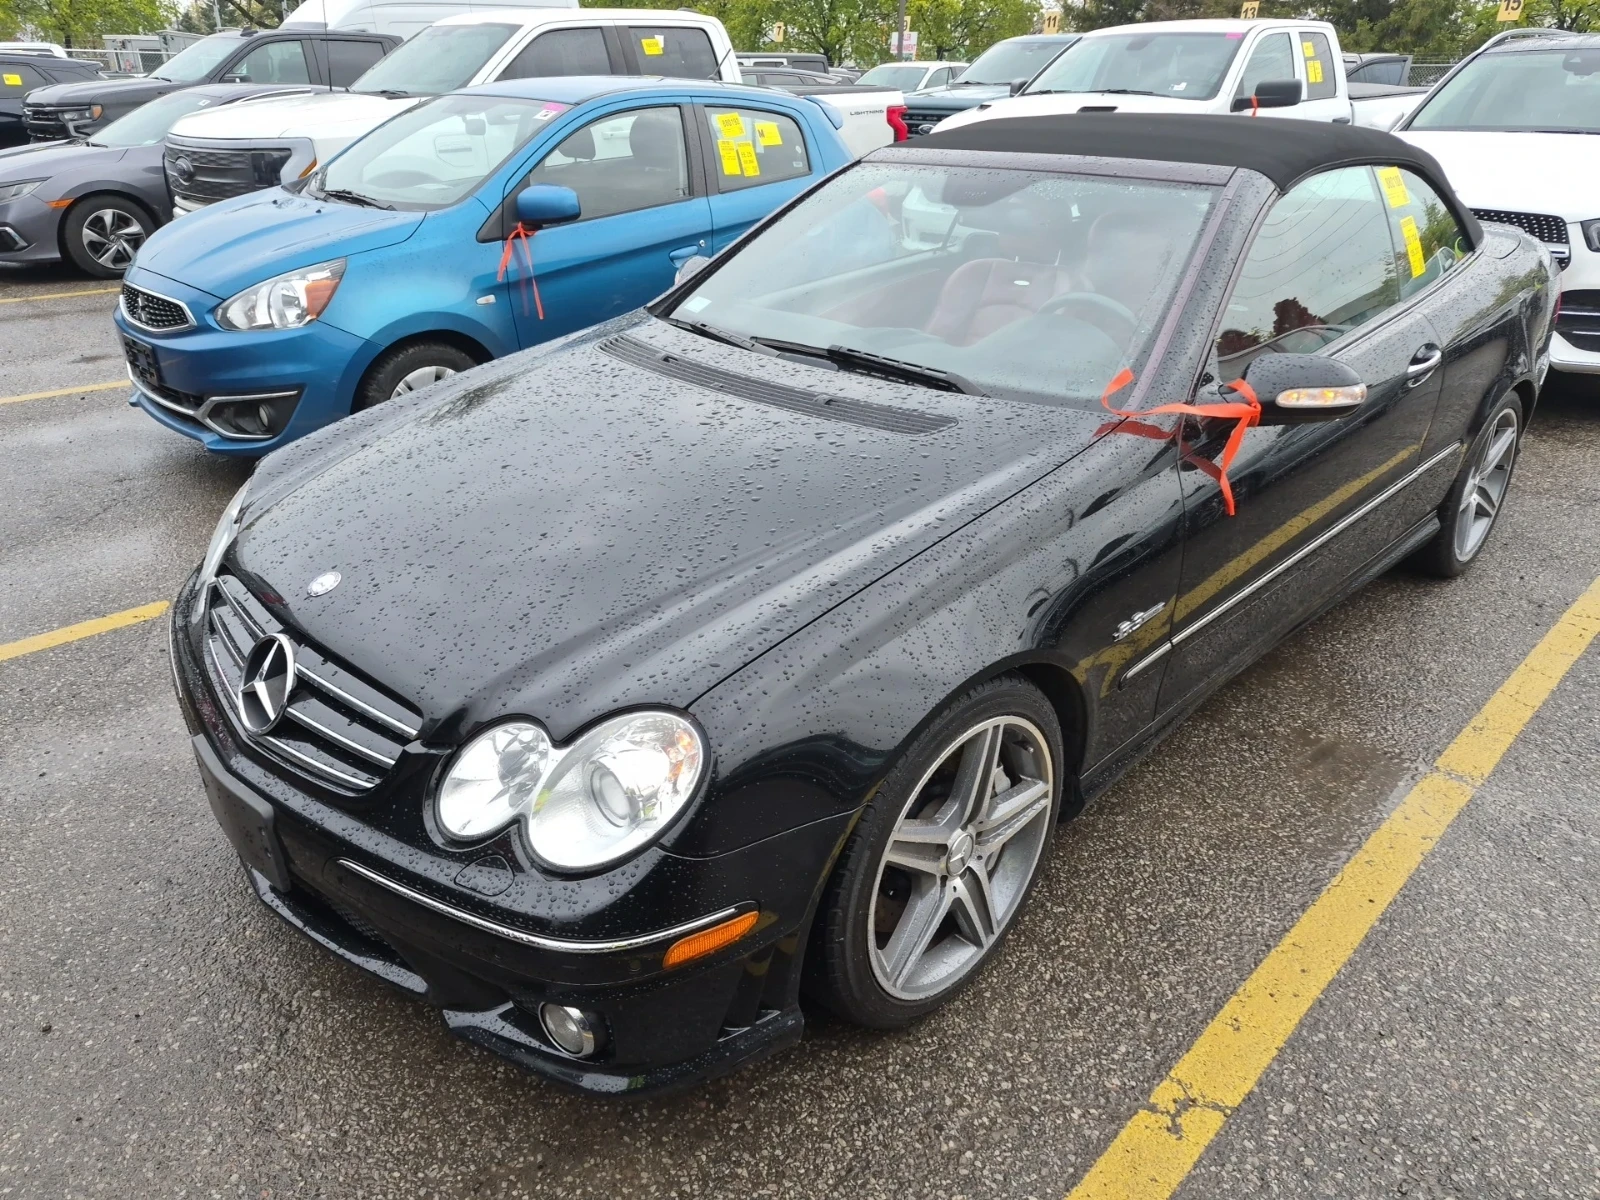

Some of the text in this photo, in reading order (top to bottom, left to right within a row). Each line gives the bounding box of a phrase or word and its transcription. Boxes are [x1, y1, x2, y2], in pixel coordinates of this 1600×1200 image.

[1504, 0, 1522, 11] 15
[1243, 7, 1257, 19] 13
[1046, 15, 1057, 28] 11
[776, 25, 782, 37] 7
